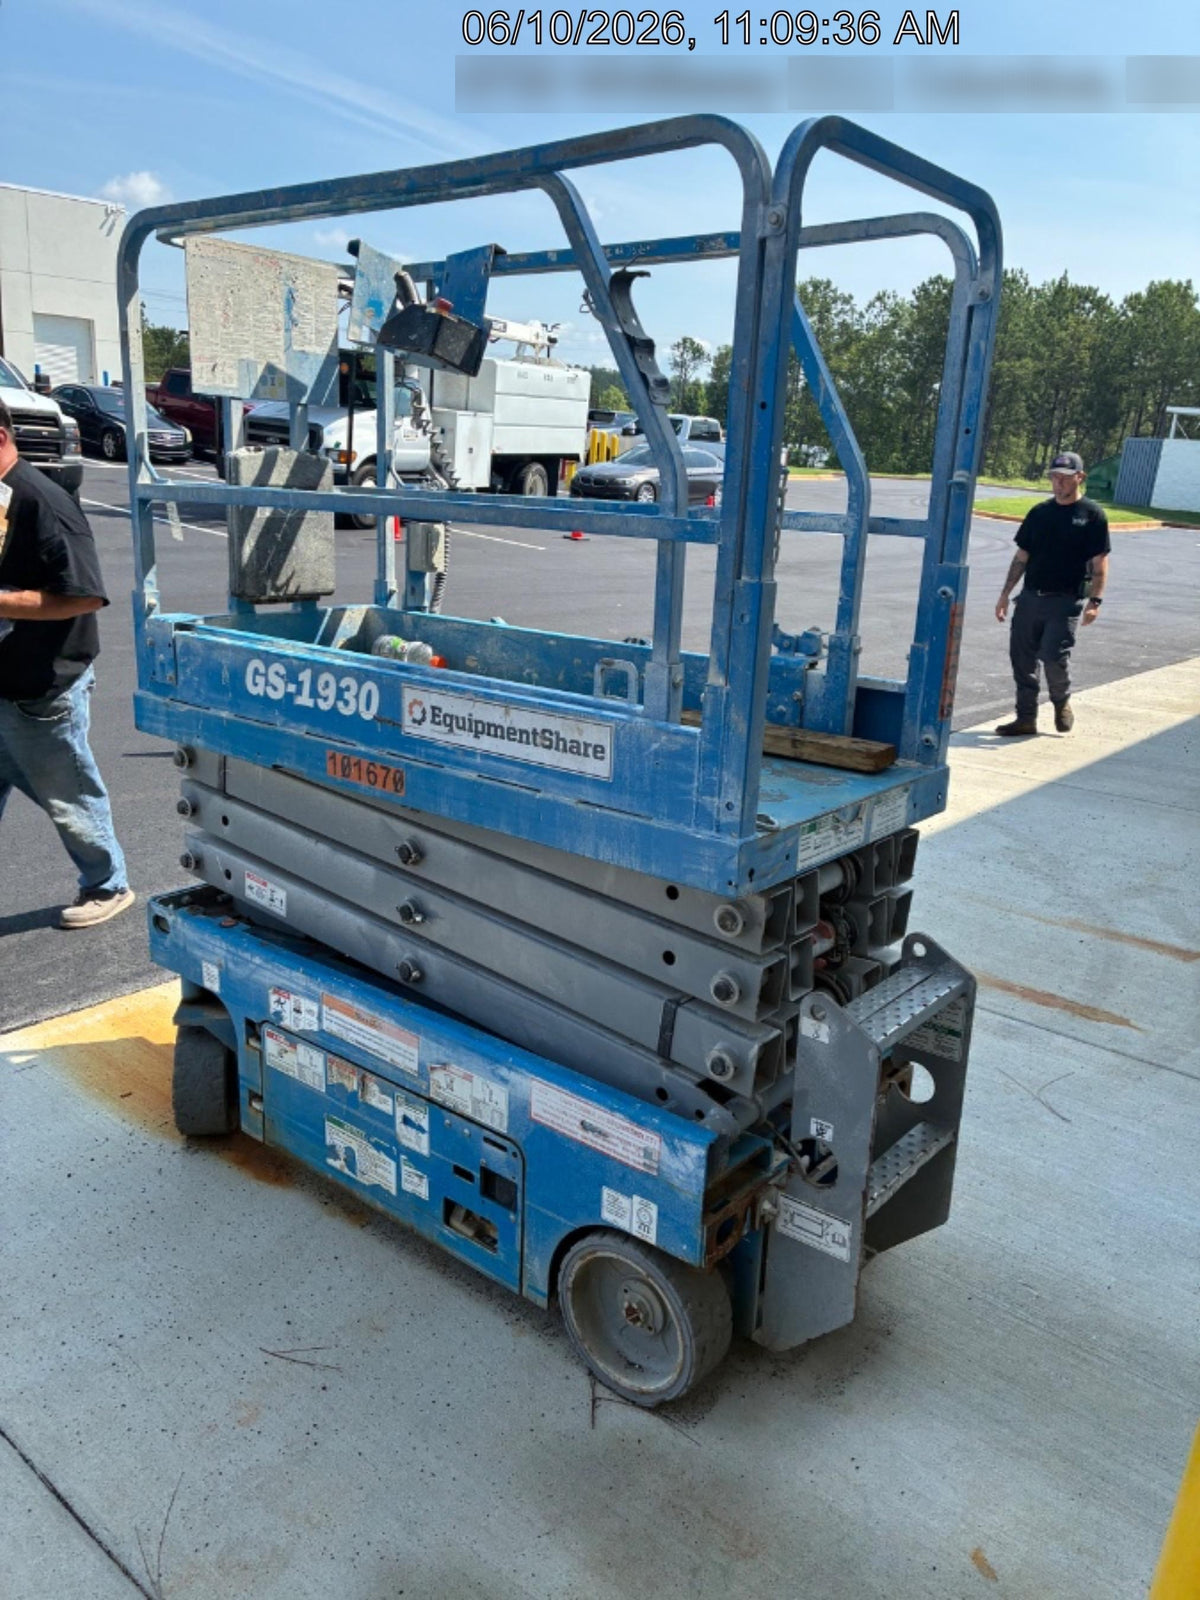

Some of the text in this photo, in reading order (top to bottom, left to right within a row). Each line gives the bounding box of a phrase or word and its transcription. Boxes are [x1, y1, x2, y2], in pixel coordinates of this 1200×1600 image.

[245, 658, 380, 721] GS-1930
[430, 705, 605, 761] EquipmentShare
[328, 752, 404, 793] 101670
